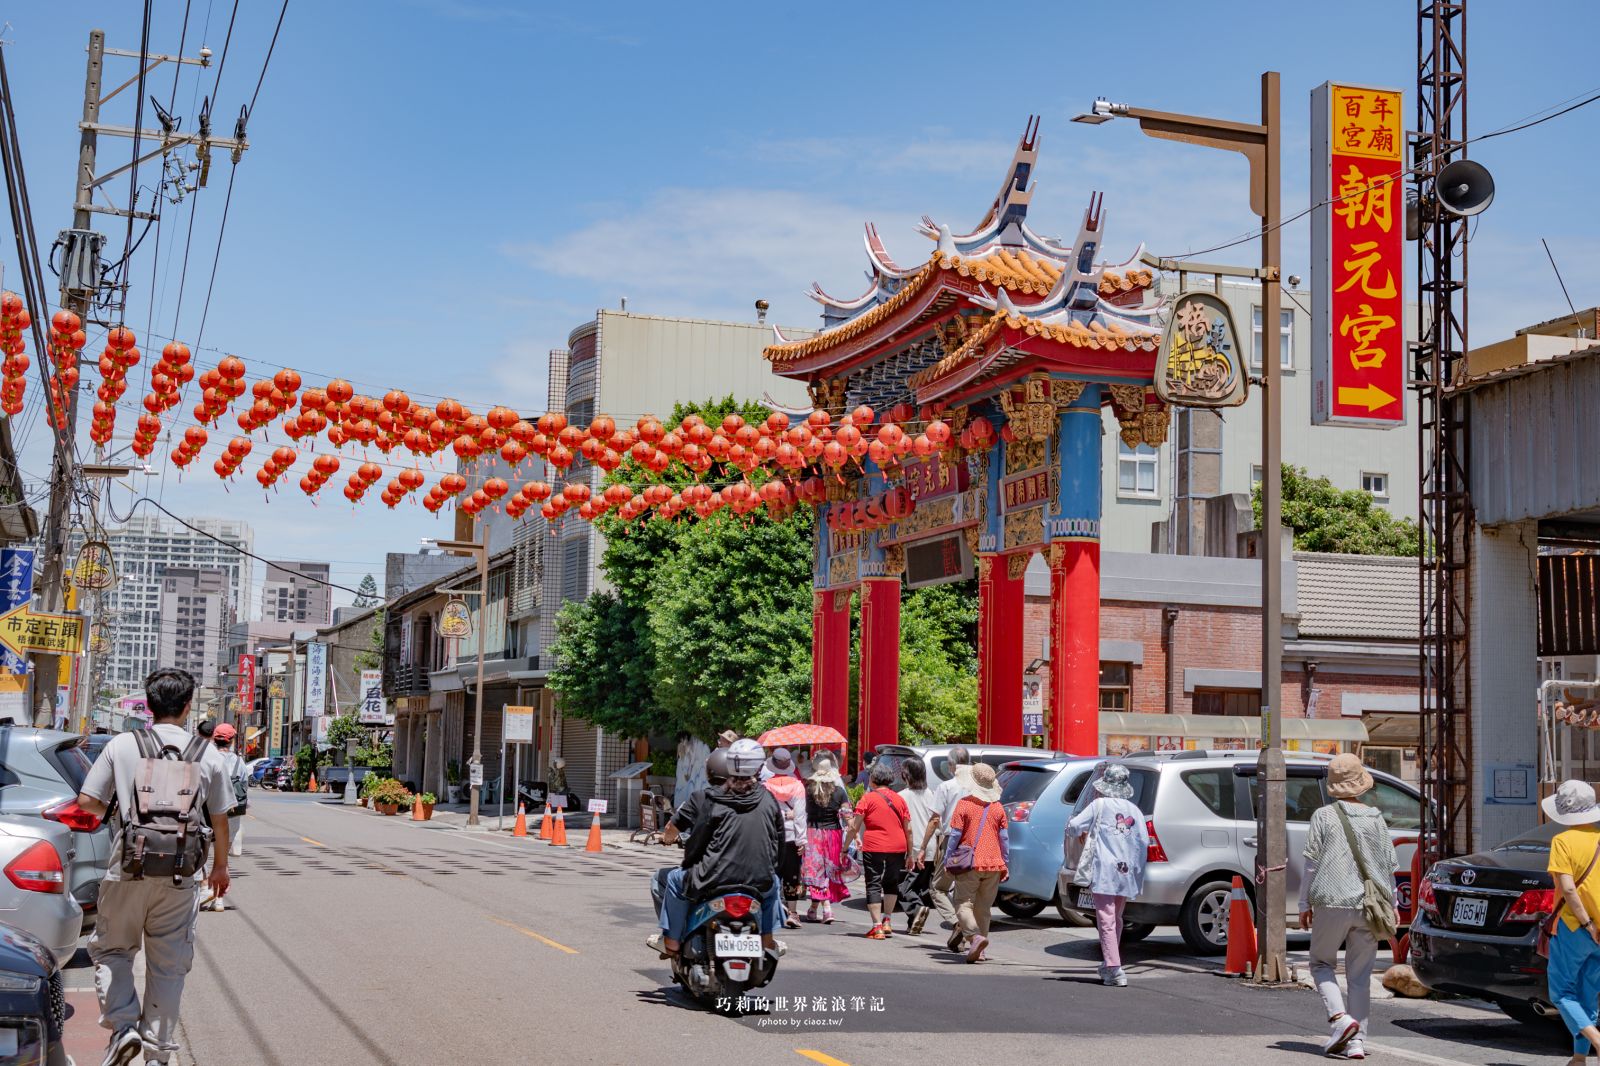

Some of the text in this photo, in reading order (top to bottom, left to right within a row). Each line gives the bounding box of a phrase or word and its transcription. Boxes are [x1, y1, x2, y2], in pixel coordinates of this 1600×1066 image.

[1341, 95, 1394, 122] 百年
[1341, 123, 1393, 153] 宮廟
[1335, 164, 1398, 370] 朝元宮
[7, 616, 79, 638] 市定古蹟
